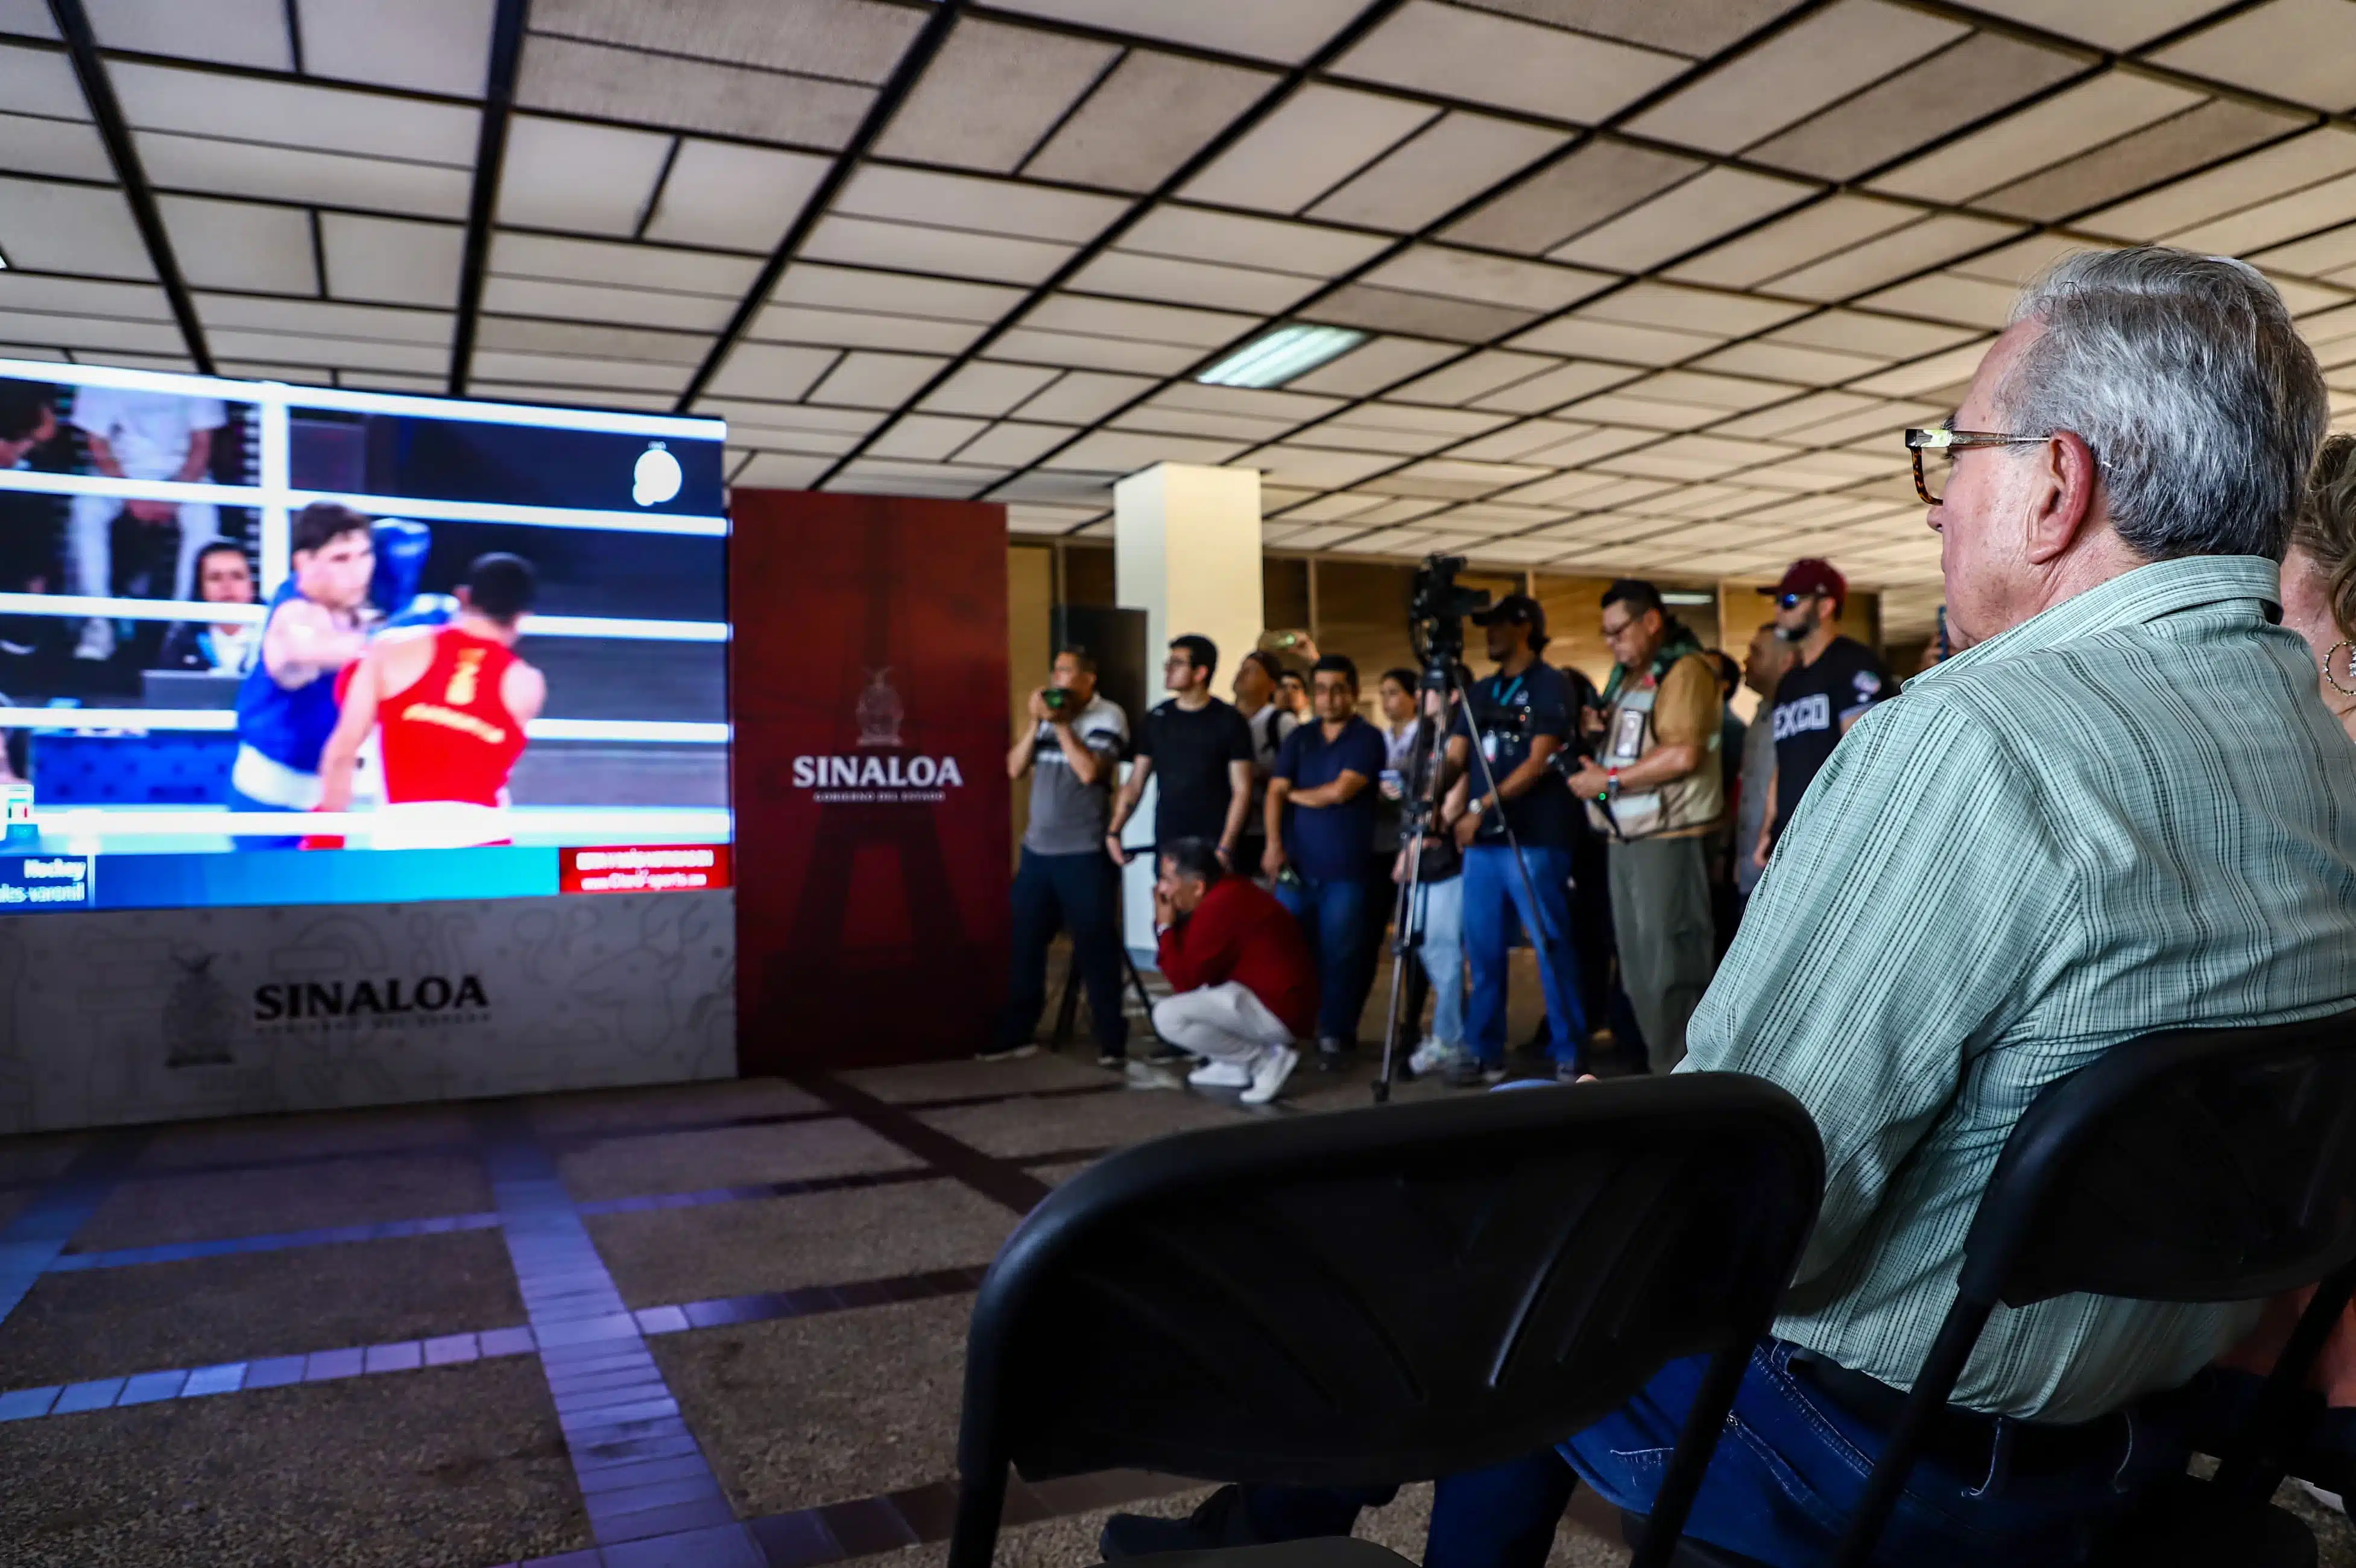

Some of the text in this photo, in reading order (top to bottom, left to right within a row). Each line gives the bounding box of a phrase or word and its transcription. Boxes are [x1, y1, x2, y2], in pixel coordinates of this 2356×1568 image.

[1773, 694, 1830, 742] EXCO
[792, 755, 964, 788] SINALOA
[254, 974, 489, 1021] SINALOA
